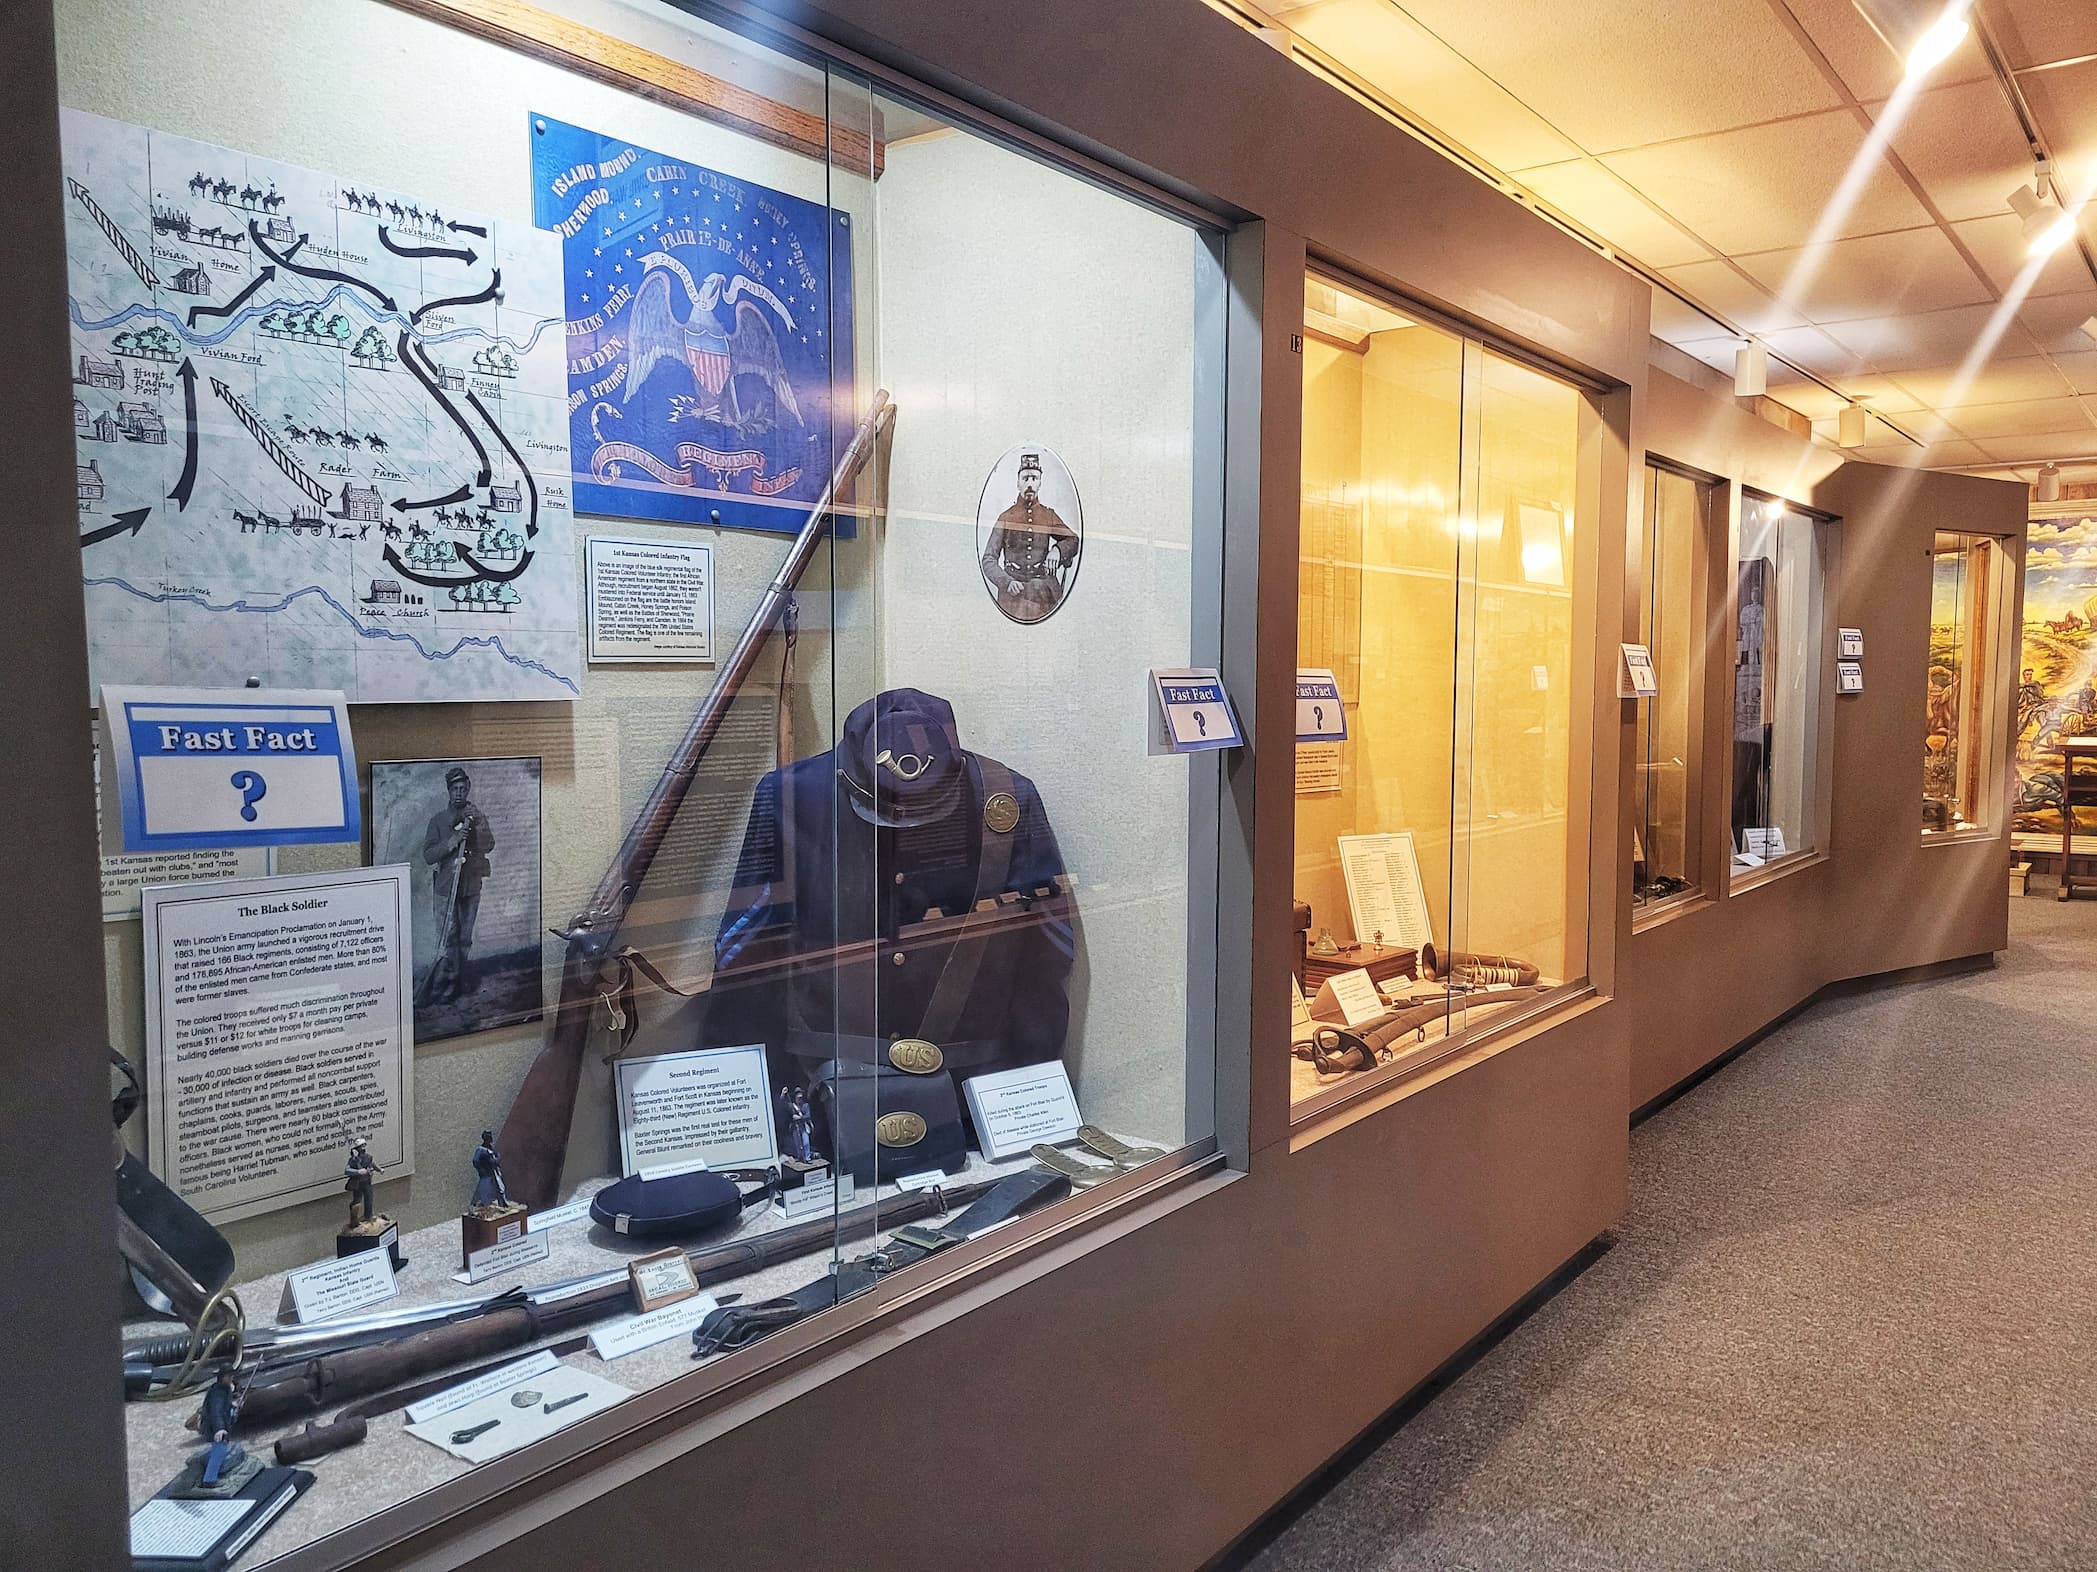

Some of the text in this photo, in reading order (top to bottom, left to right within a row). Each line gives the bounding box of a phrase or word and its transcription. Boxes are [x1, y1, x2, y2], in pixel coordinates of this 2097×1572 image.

[551, 148, 641, 198] ISLAND MOUND.
[646, 165, 687, 183] CABIN
[397, 223, 447, 243] Livingston
[150, 246, 240, 271] Vivian Home
[309, 243, 369, 263] Hyden House
[602, 283, 634, 320] FERRY.
[201, 346, 263, 363] Vivian Ford
[567, 335, 626, 374] AMDEN.
[133, 367, 165, 380] Hunt
[590, 363, 629, 399] SPRINGS.
[133, 376, 174, 395] Trading
[134, 384, 159, 397] Post
[471, 377, 500, 391] Finney
[259, 418, 285, 446] Escape
[283, 444, 306, 466] Route
[525, 439, 569, 455] Livingston
[319, 462, 401, 479] Rader Farm
[546, 499, 566, 509] Home
[659, 552, 679, 561] Infantry
[158, 582, 212, 597] Turkey Creek
[359, 607, 430, 618] Peace Church
[1169, 687, 1216, 701] Fast Fact
[1296, 685, 1333, 698] Fast Fact
[1193, 711, 1206, 737] ?
[1313, 705, 1323, 730] ?
[157, 725, 318, 751] Fast Fact
[230, 770, 267, 822] ?
[106, 849, 235, 866] 1st Kansas reported finding the
[133, 865, 147, 874] out
[149, 864, 167, 873] with
[198, 860, 214, 869] and
[216, 859, 239, 868] "most
[117, 878, 139, 888] large
[141, 875, 166, 884] Union
[168, 871, 190, 881] force
[191, 869, 221, 879] burned
[222, 868, 235, 877] the
[238, 898, 328, 917] The Black Soldier
[172, 938, 191, 947] With
[193, 934, 227, 945] Lincoln's
[228, 928, 278, 940] Emancipation
[280, 922, 326, 934] Proclamation
[338, 918, 365, 927] January
[197, 948, 210, 956] the
[212, 944, 235, 954] Union
[236, 942, 255, 951] army
[257, 936, 290, 948] launched
[298, 933, 328, 943] vigorous
[329, 927, 367, 938] recruitment
[368, 925, 384, 933] drive
[173, 961, 189, 970] that
[191, 958, 215, 968] raised
[217, 955, 231, 964] 166
[233, 952, 254, 962] Black
[295, 943, 329, 954] consisting
[330, 940, 338, 948] of
[359, 936, 384, 944] officers
[174, 972, 189, 982] and
[288, 955, 316, 965] enlisted
[336, 950, 354, 958] More
[355, 948, 370, 956] than
[174, 996, 194, 1004] were
[196, 991, 222, 1001] former
[897, 1044, 936, 1069] US
[669, 1066, 719, 1078] Second Regiment
[879, 1117, 918, 1143] US
